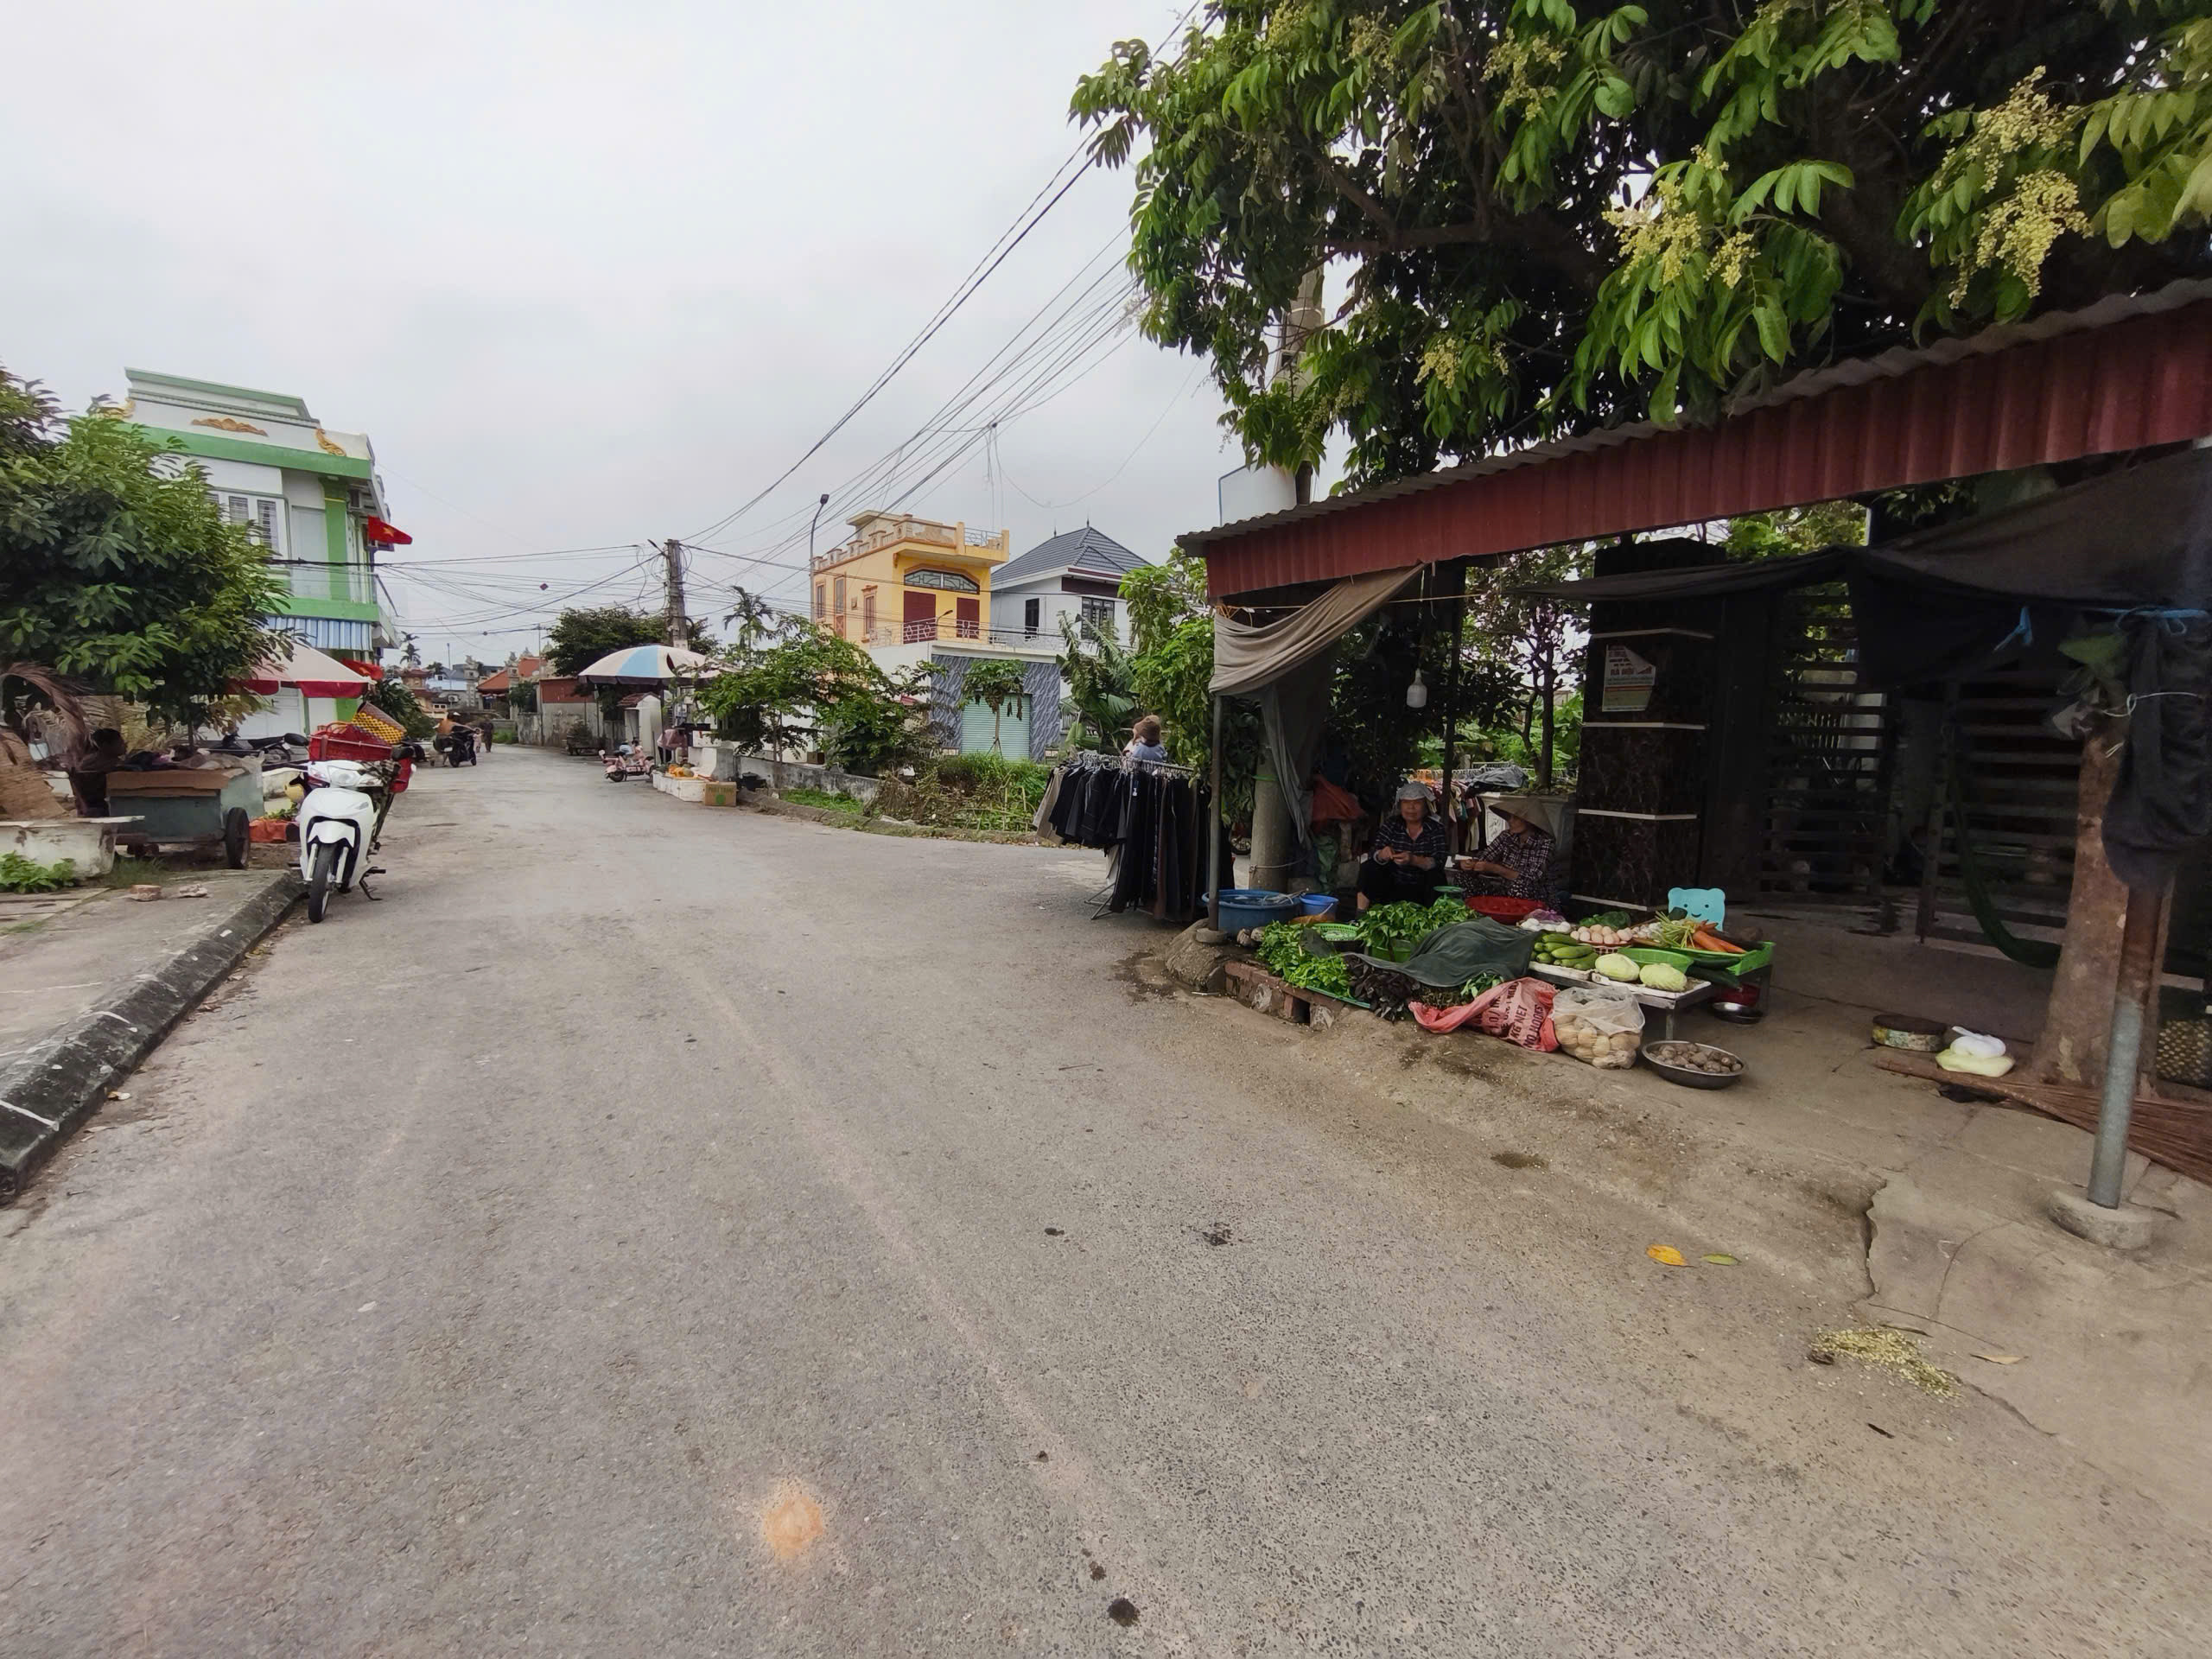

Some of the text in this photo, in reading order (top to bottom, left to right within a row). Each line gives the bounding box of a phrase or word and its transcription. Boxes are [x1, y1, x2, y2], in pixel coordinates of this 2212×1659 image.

[1510, 1005, 1528, 1039] KG NET
[1522, 1004, 1543, 1048] NO HOOKS
